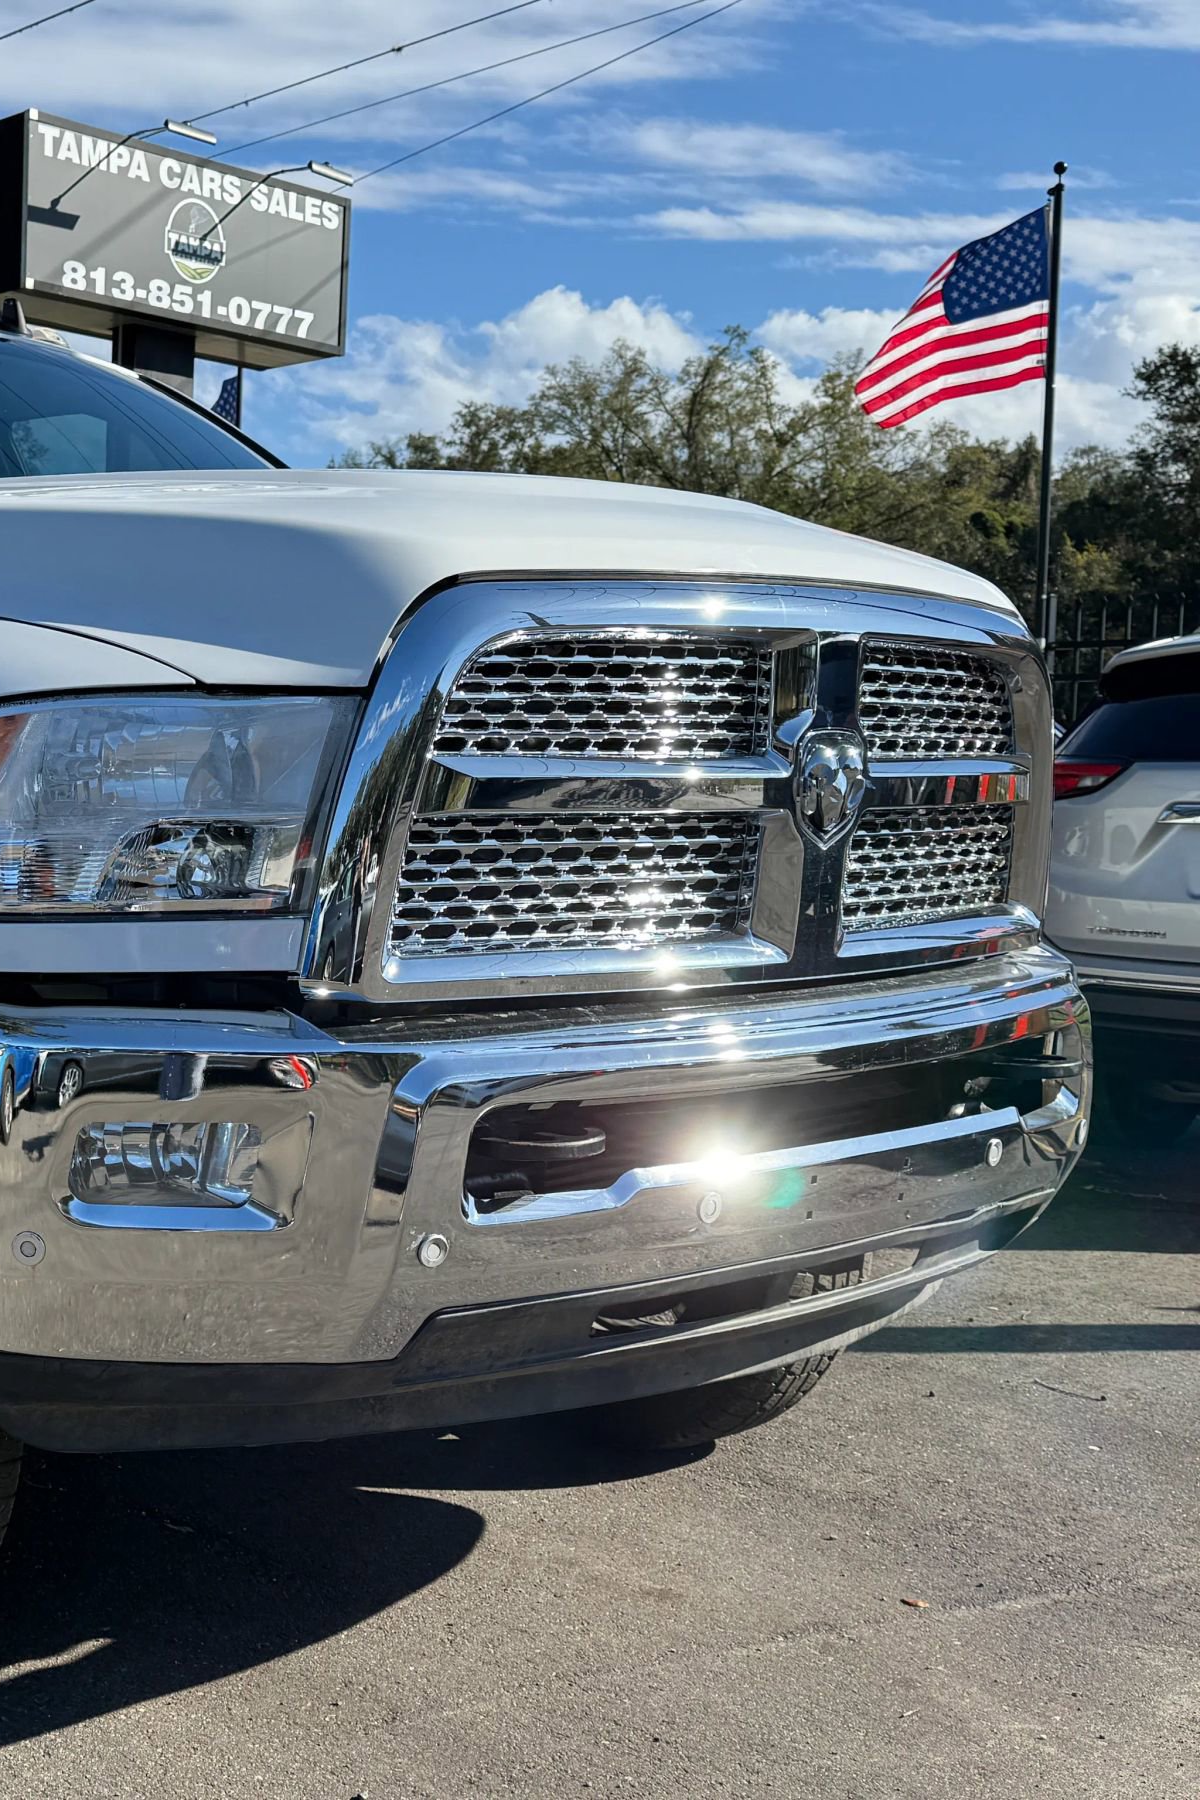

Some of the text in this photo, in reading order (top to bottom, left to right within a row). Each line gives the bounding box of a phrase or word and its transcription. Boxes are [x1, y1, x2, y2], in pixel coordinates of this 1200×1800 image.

[37, 123, 340, 230] TAMPA CARS SALES
[62, 260, 315, 339] 813-851-0777
